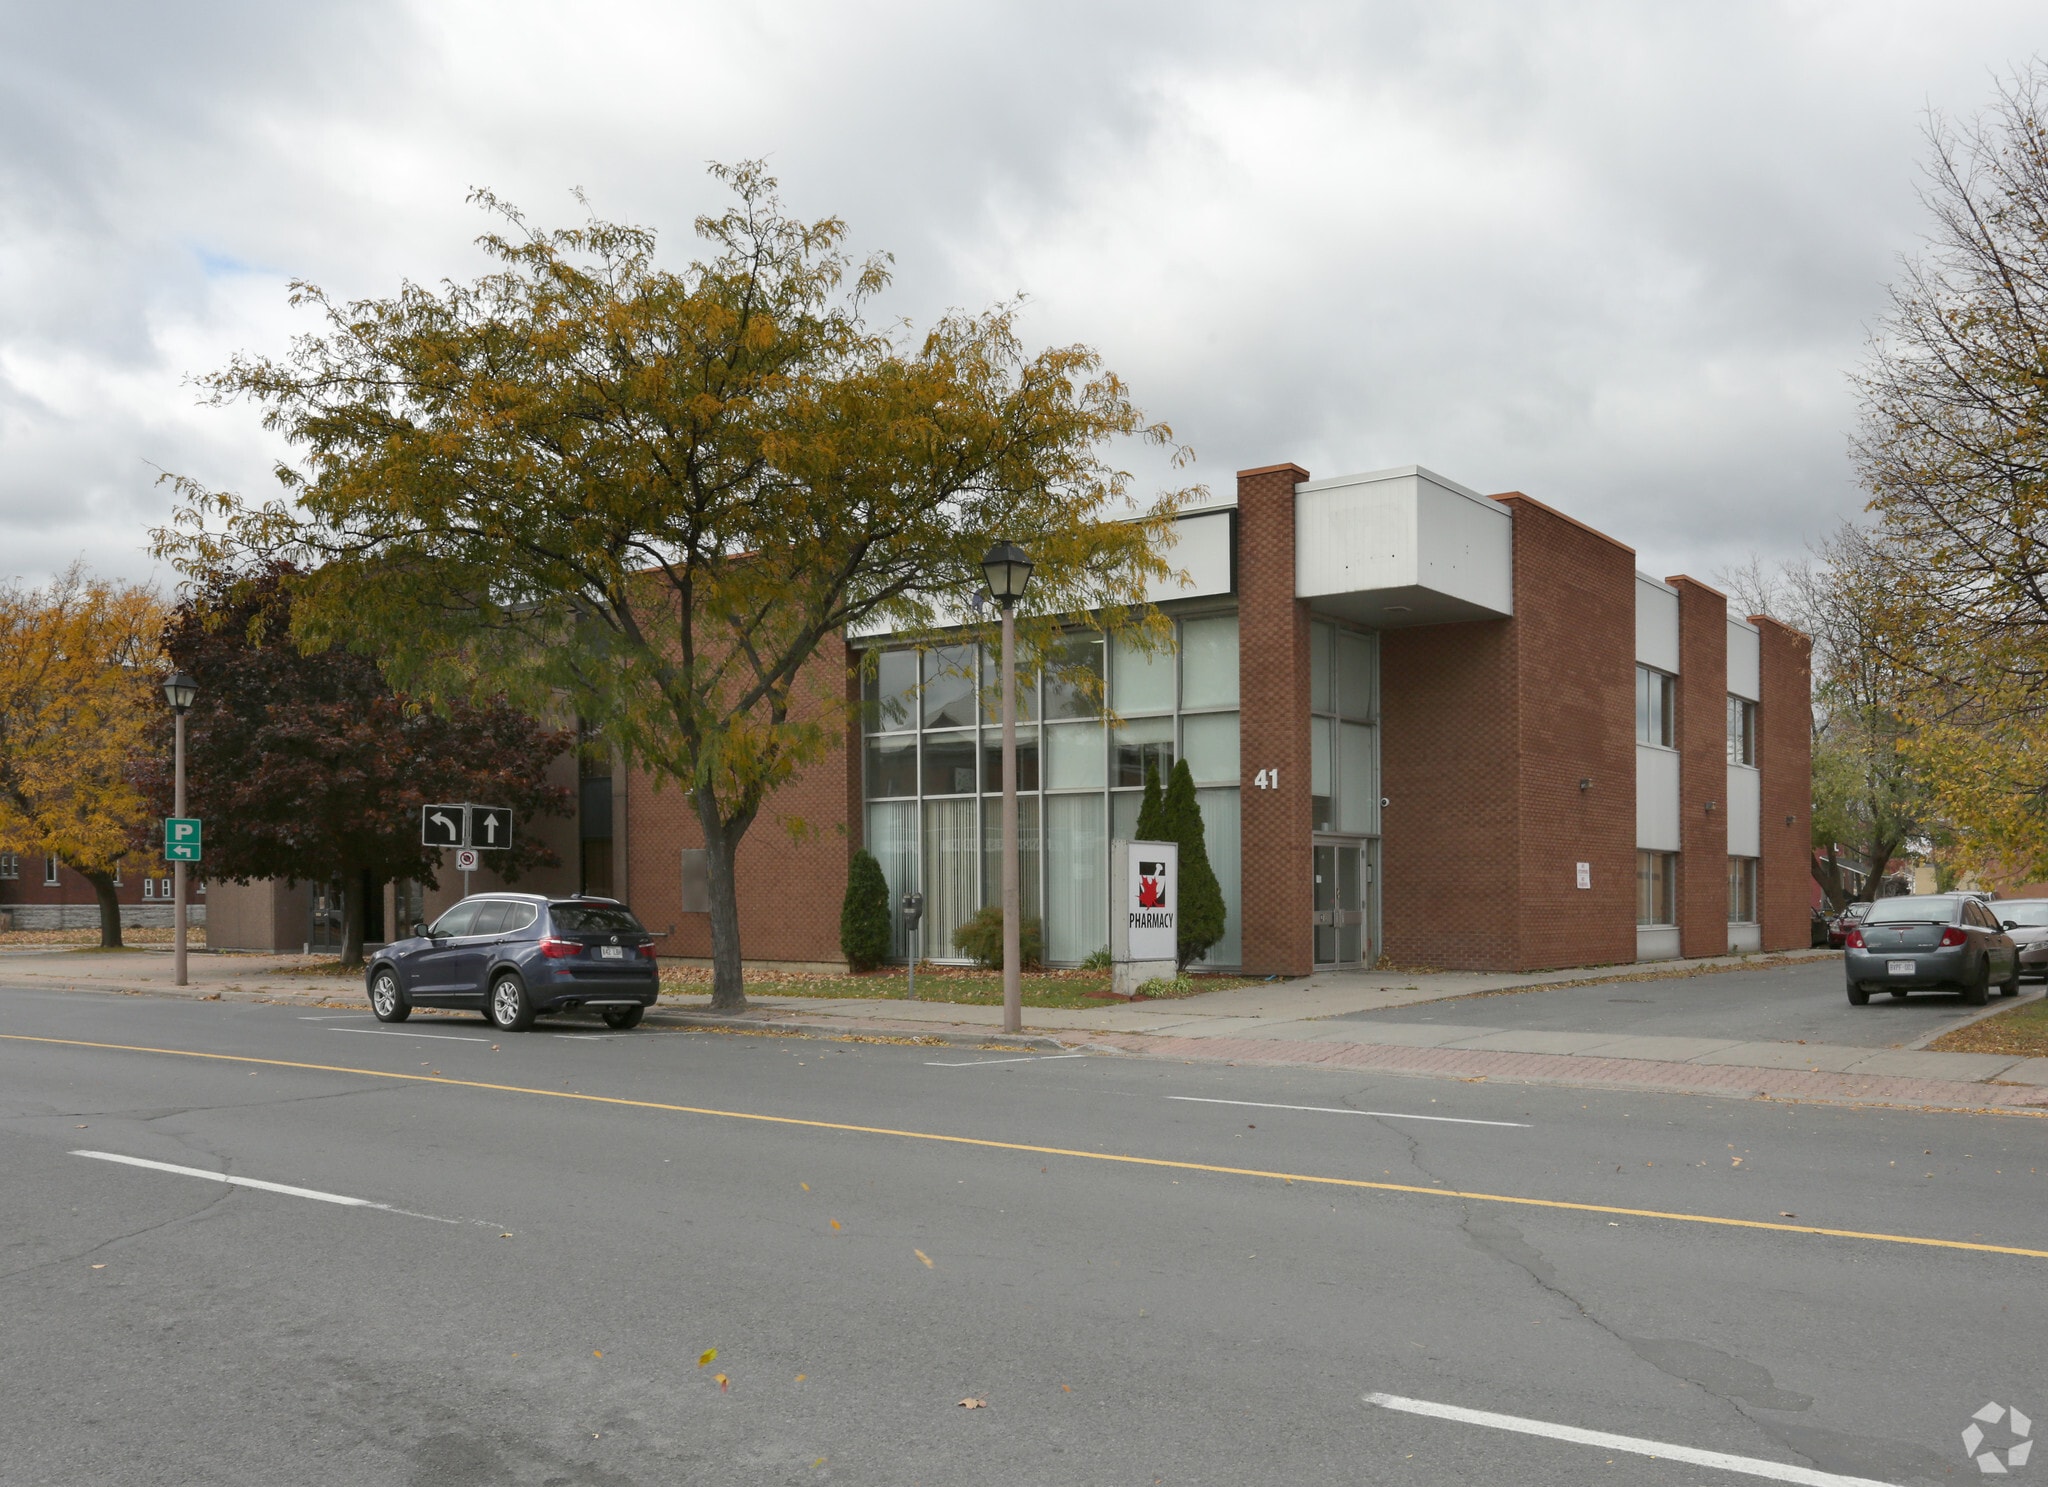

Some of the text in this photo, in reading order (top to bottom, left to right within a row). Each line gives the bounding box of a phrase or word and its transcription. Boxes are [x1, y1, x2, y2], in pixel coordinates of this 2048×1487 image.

[1254, 768, 1278, 789] 41
[175, 824, 193, 840] P
[1129, 913, 1174, 928] PHARMACY
